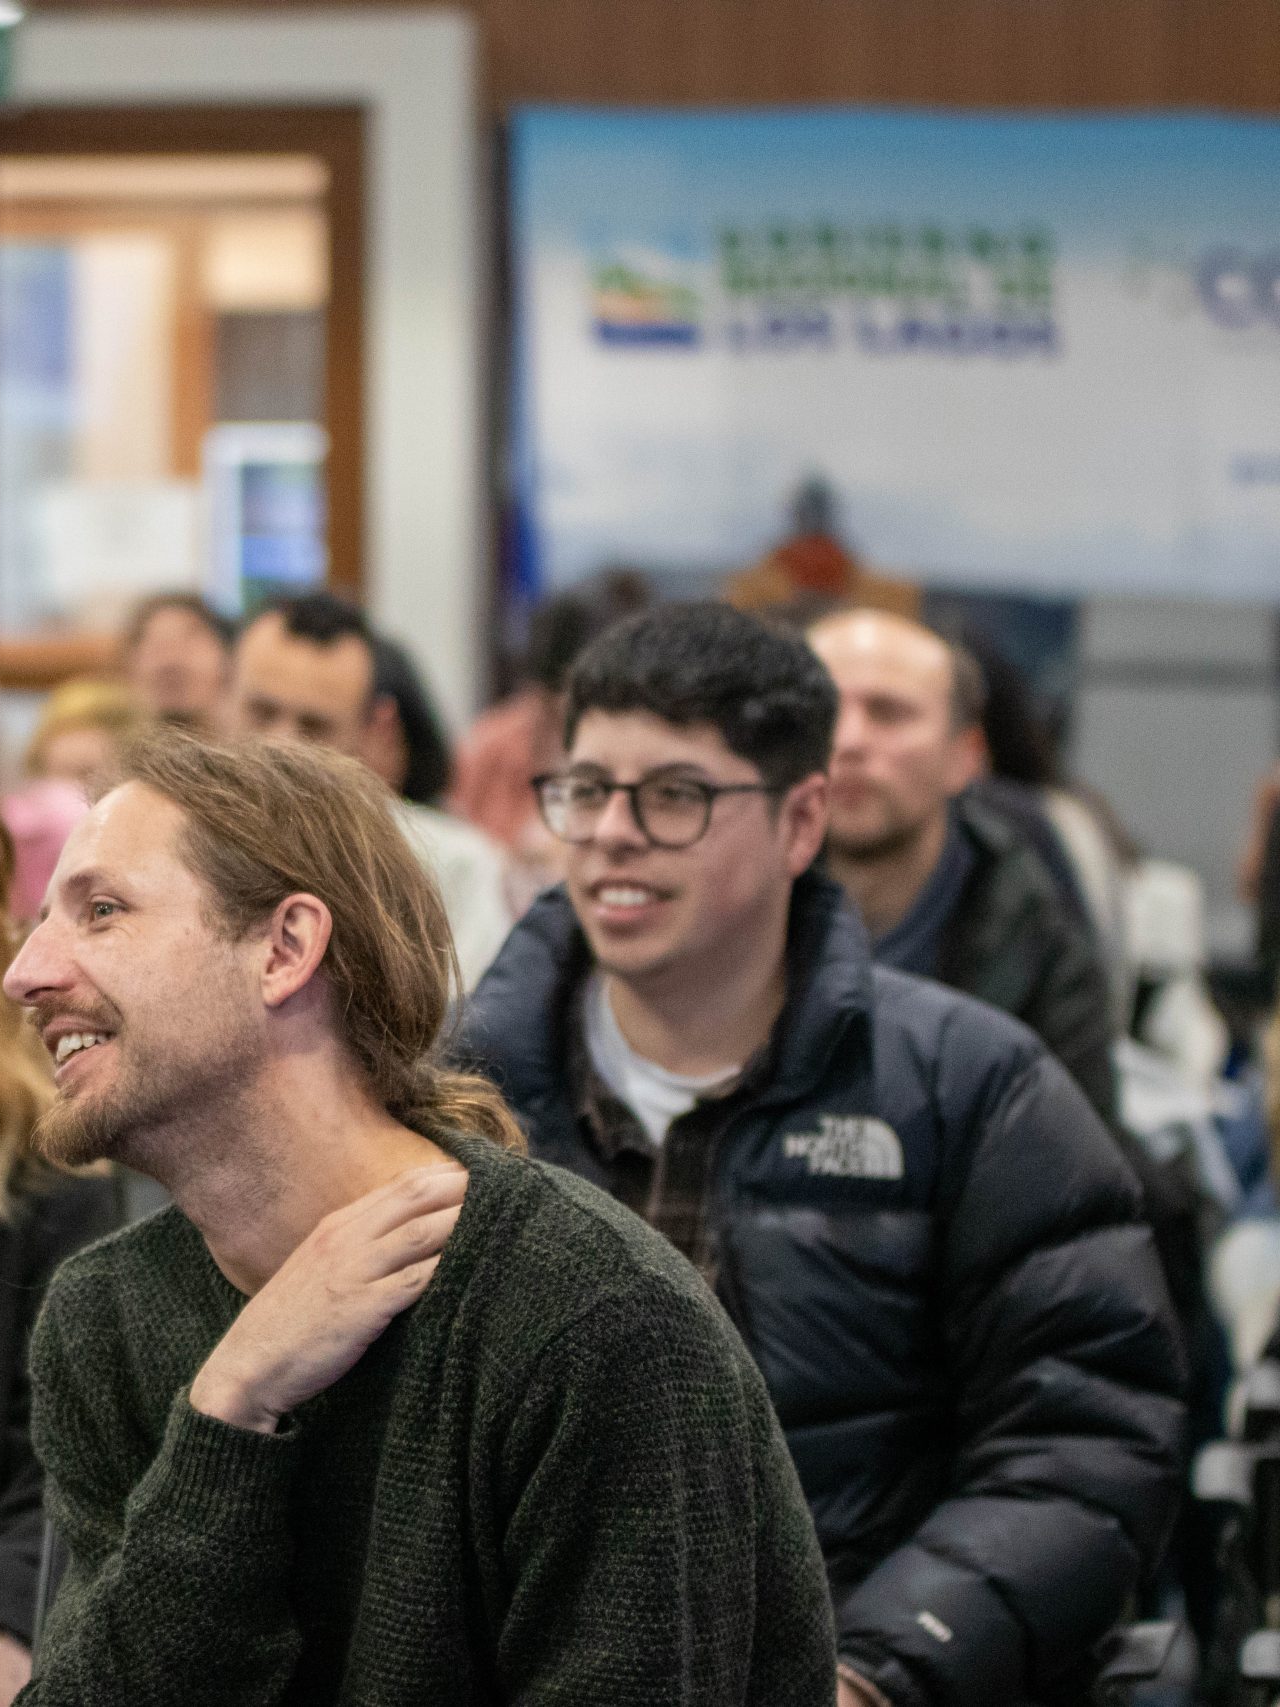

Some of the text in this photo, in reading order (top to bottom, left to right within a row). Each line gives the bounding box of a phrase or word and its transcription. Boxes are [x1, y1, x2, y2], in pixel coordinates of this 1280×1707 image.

[821, 1114, 863, 1137] THE
[783, 1134, 863, 1158] NORTH
[808, 1156, 863, 1177] FACE
